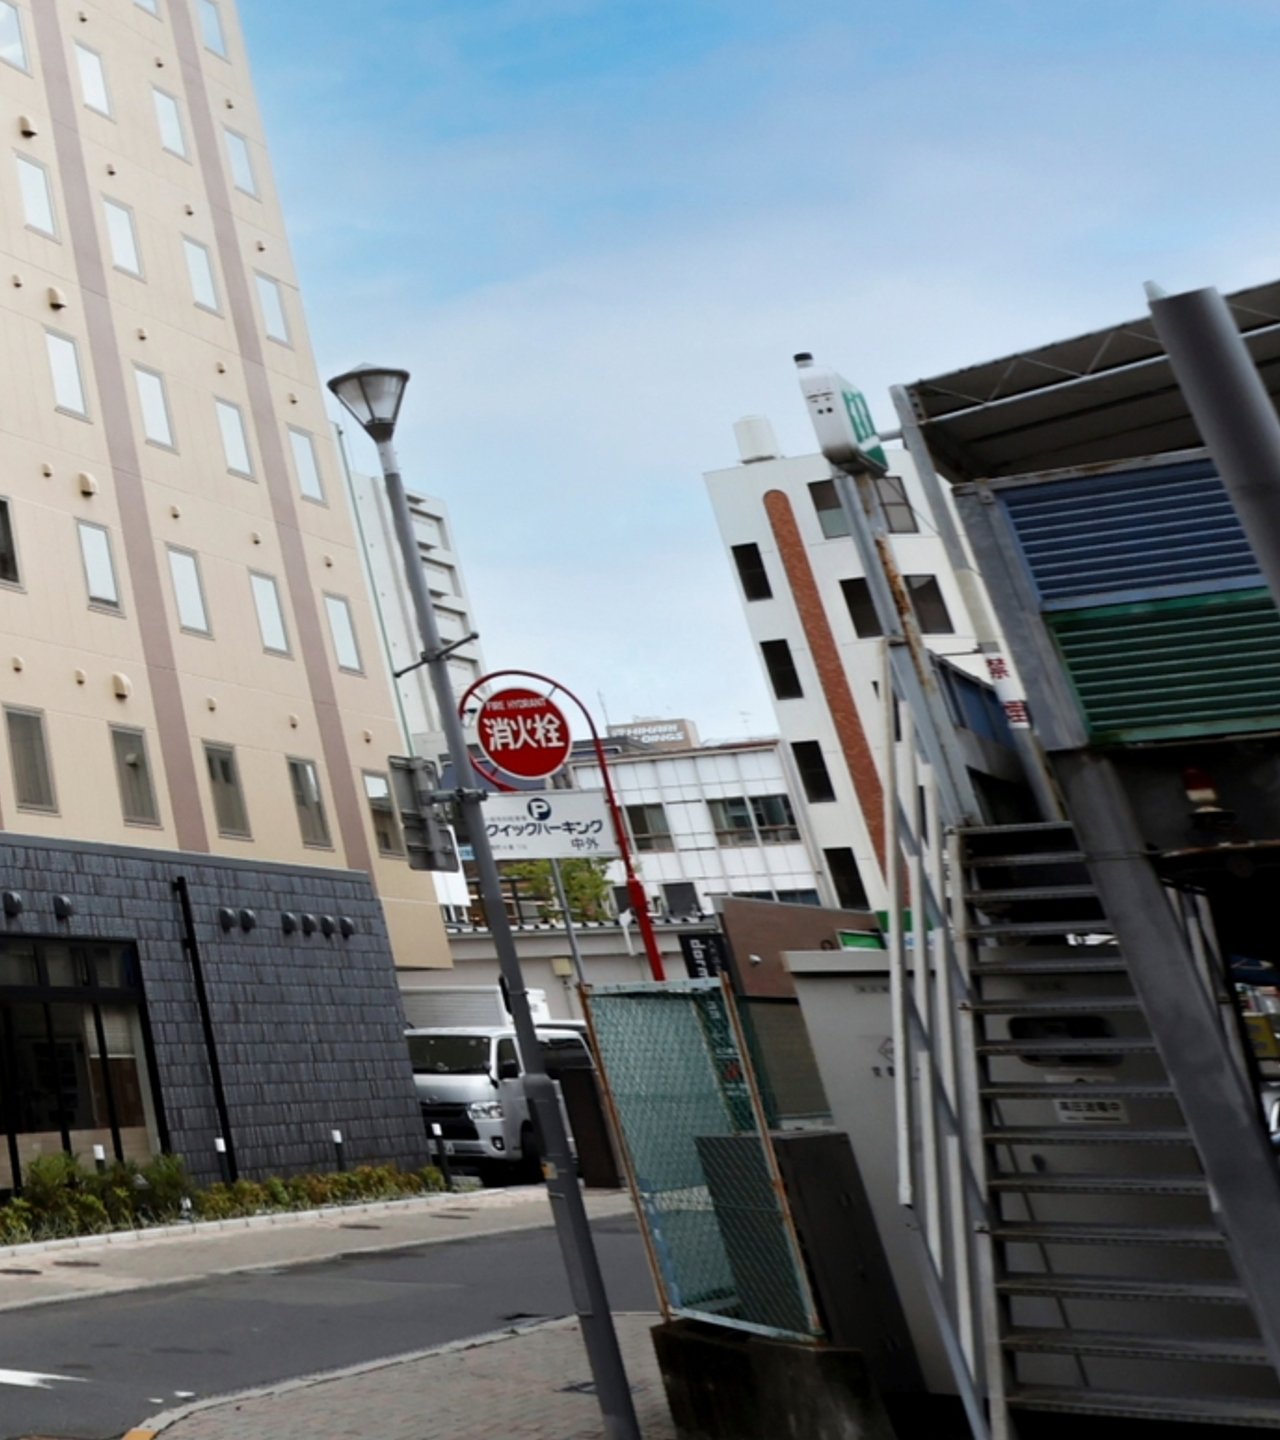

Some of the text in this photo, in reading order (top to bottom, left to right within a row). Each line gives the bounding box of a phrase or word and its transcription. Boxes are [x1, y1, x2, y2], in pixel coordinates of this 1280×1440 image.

[486, 697, 547, 711] FIRE HYDRANT
[482, 712, 565, 752] 消火栓
[528, 799, 549, 820] P
[690, 938, 711, 978] dorm
